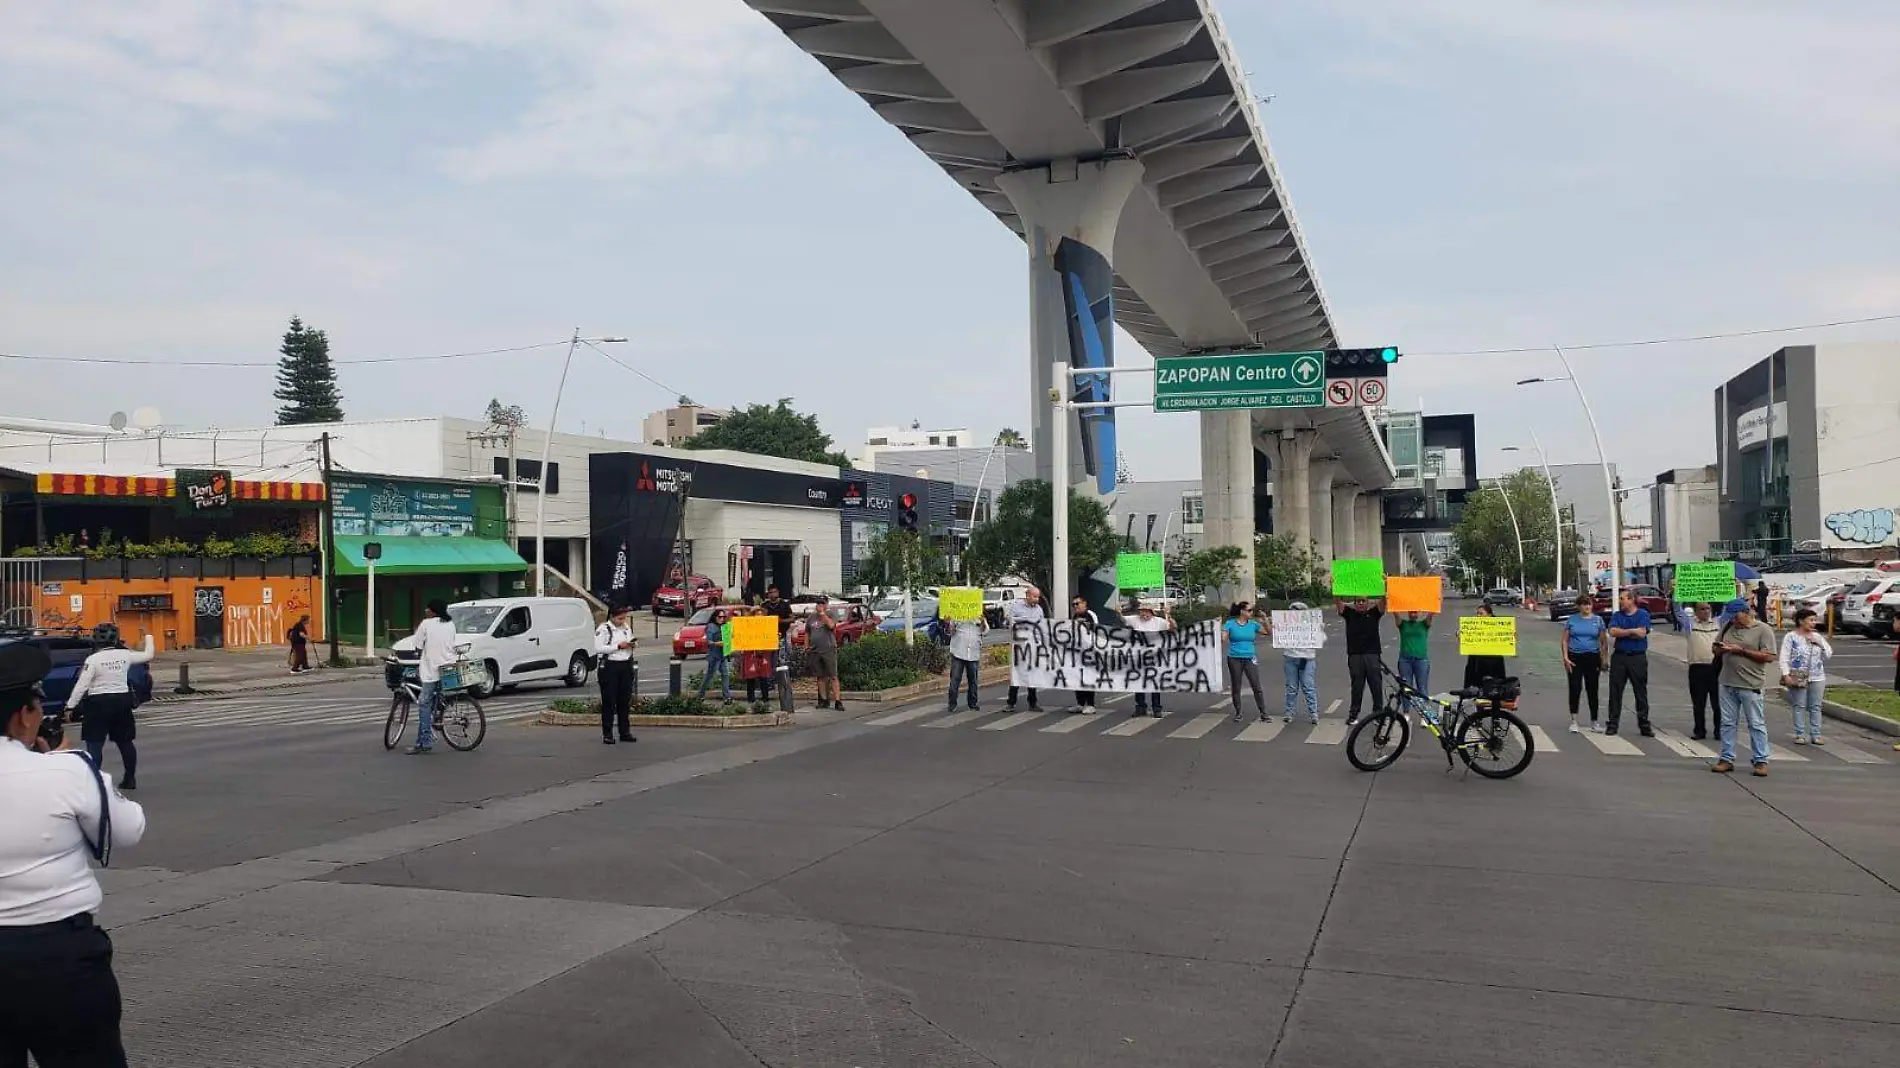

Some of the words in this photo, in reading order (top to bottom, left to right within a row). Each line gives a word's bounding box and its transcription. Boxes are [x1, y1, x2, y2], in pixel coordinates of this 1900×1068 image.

[1158, 367, 1230, 384] ZAPOPAN
[1236, 365, 1287, 381] Centro
[1366, 384, 1379, 395] 60
[187, 485, 214, 498] Don
[808, 488, 827, 501] Country
[1013, 643, 1198, 672] MANTENIMIENTO
[1053, 668, 1067, 688] A
[1080, 667, 1113, 689] LA
[1125, 667, 1211, 693] PRESA
